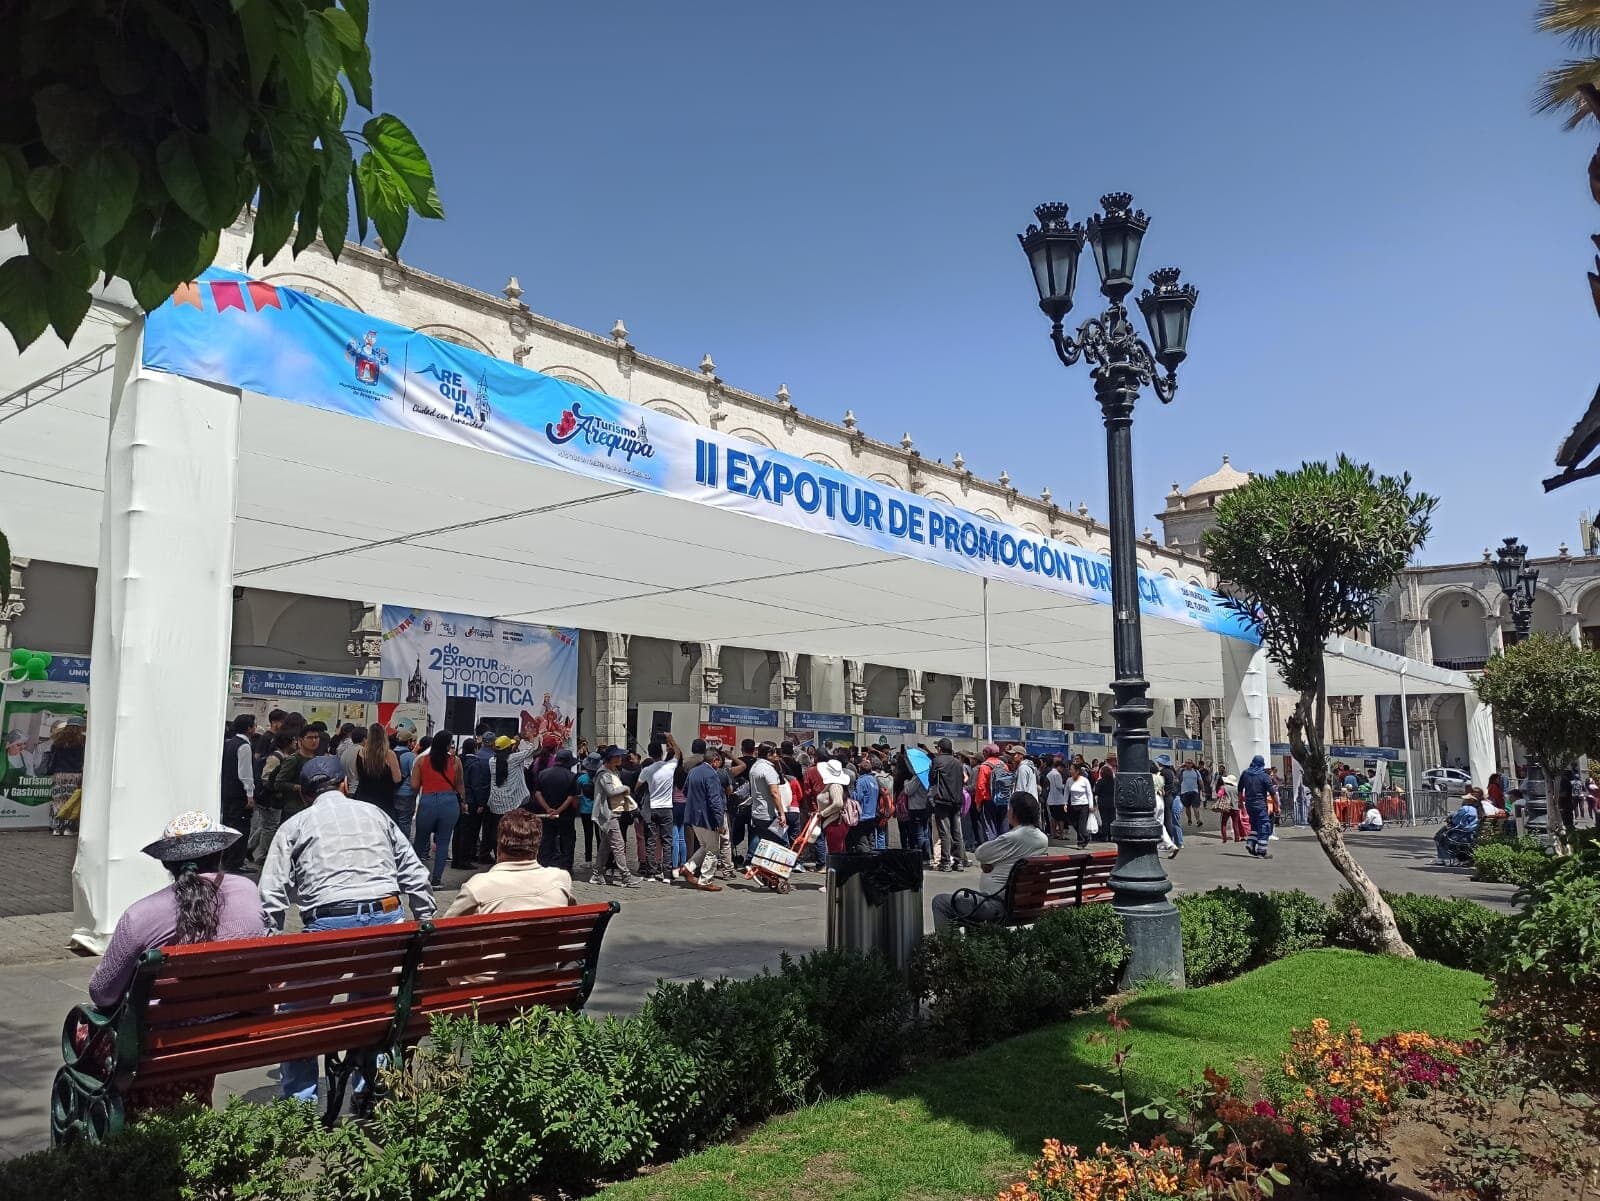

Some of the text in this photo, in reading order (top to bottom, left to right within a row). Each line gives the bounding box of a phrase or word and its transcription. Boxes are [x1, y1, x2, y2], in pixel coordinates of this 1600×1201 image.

[546, 402, 656, 463] Arequipa
[594, 416, 637, 439] Turismo
[695, 438, 718, 488] II
[726, 447, 884, 533] EXPOTUR
[888, 498, 925, 545] DE
[928, 510, 1073, 583] PROMOCIÓN
[1072, 555, 1164, 607] TURCA
[443, 642, 460, 655] do
[443, 654, 511, 672] EXPOTUR de
[442, 666, 534, 688] promoción
[264, 681, 296, 690] INSTITUTO
[337, 686, 364, 695] SUPERIOR
[441, 680, 535, 706] TURÍSTICA
[19, 776, 53, 786] Turismo
[3, 788, 10, 798] y
